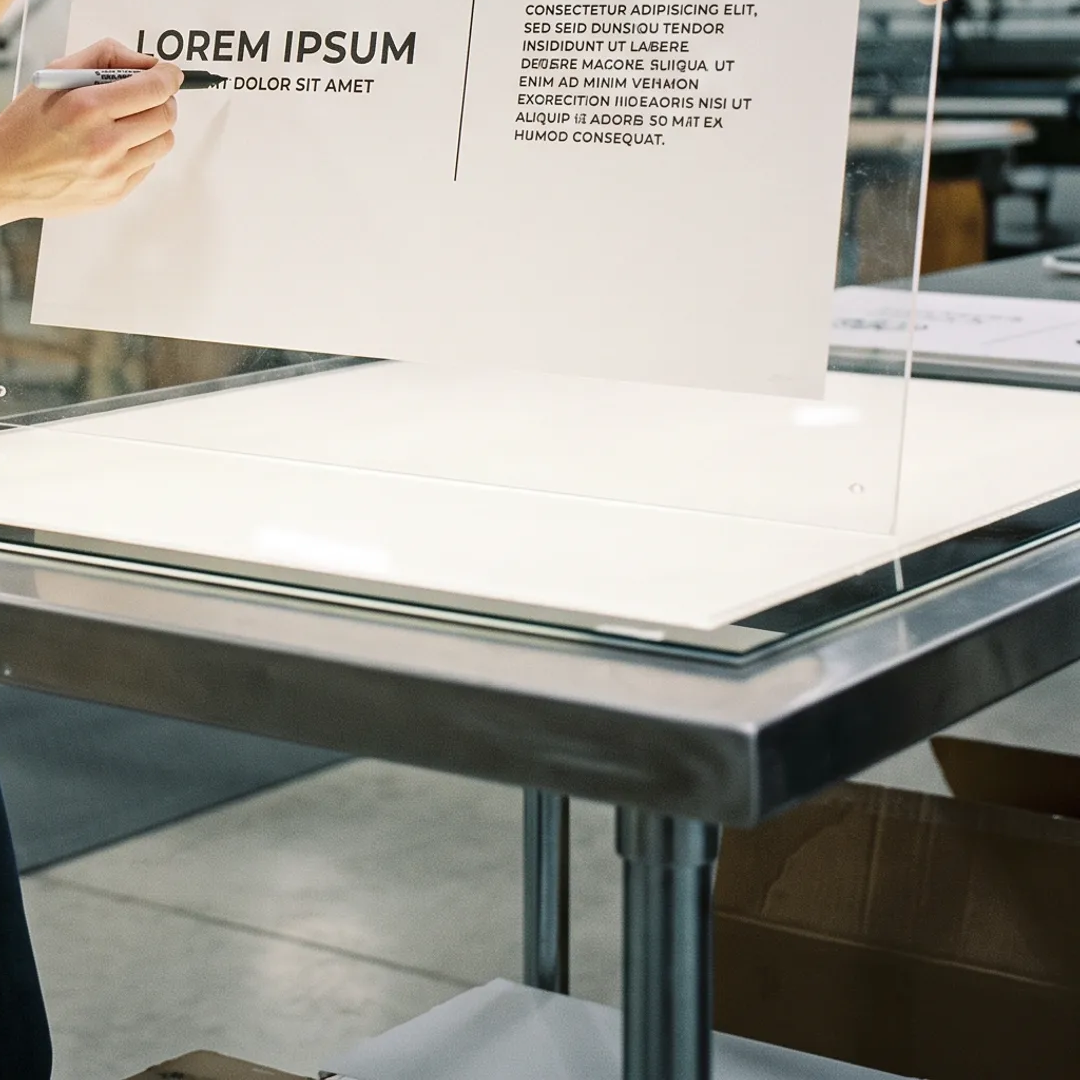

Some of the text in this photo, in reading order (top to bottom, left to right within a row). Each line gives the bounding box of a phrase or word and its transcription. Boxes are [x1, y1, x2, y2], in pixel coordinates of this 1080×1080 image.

[525, 4, 758, 18] CONSECTETUR ADIPISICING ELIT,
[524, 22, 551, 34] SED
[555, 22, 587, 34] SEID
[663, 22, 724, 35] TENDOR
[137, 29, 417, 65] LOREM IPSUM
[522, 40, 604, 52] INSIDIDUNT
[608, 40, 626, 52] UT
[715, 60, 735, 72] UT
[234, 77, 291, 91] DOLOR
[296, 78, 322, 92] SIT
[325, 78, 375, 94] AMET
[519, 75, 554, 88] ENIM
[558, 76, 579, 88] AD
[583, 77, 627, 89] MINIM
[698, 97, 727, 110] NISI
[732, 98, 752, 110] UT
[516, 111, 570, 126] ALIQUIP
[703, 116, 724, 129] EX
[514, 129, 665, 147] HUMOD CONSEQUAT.
